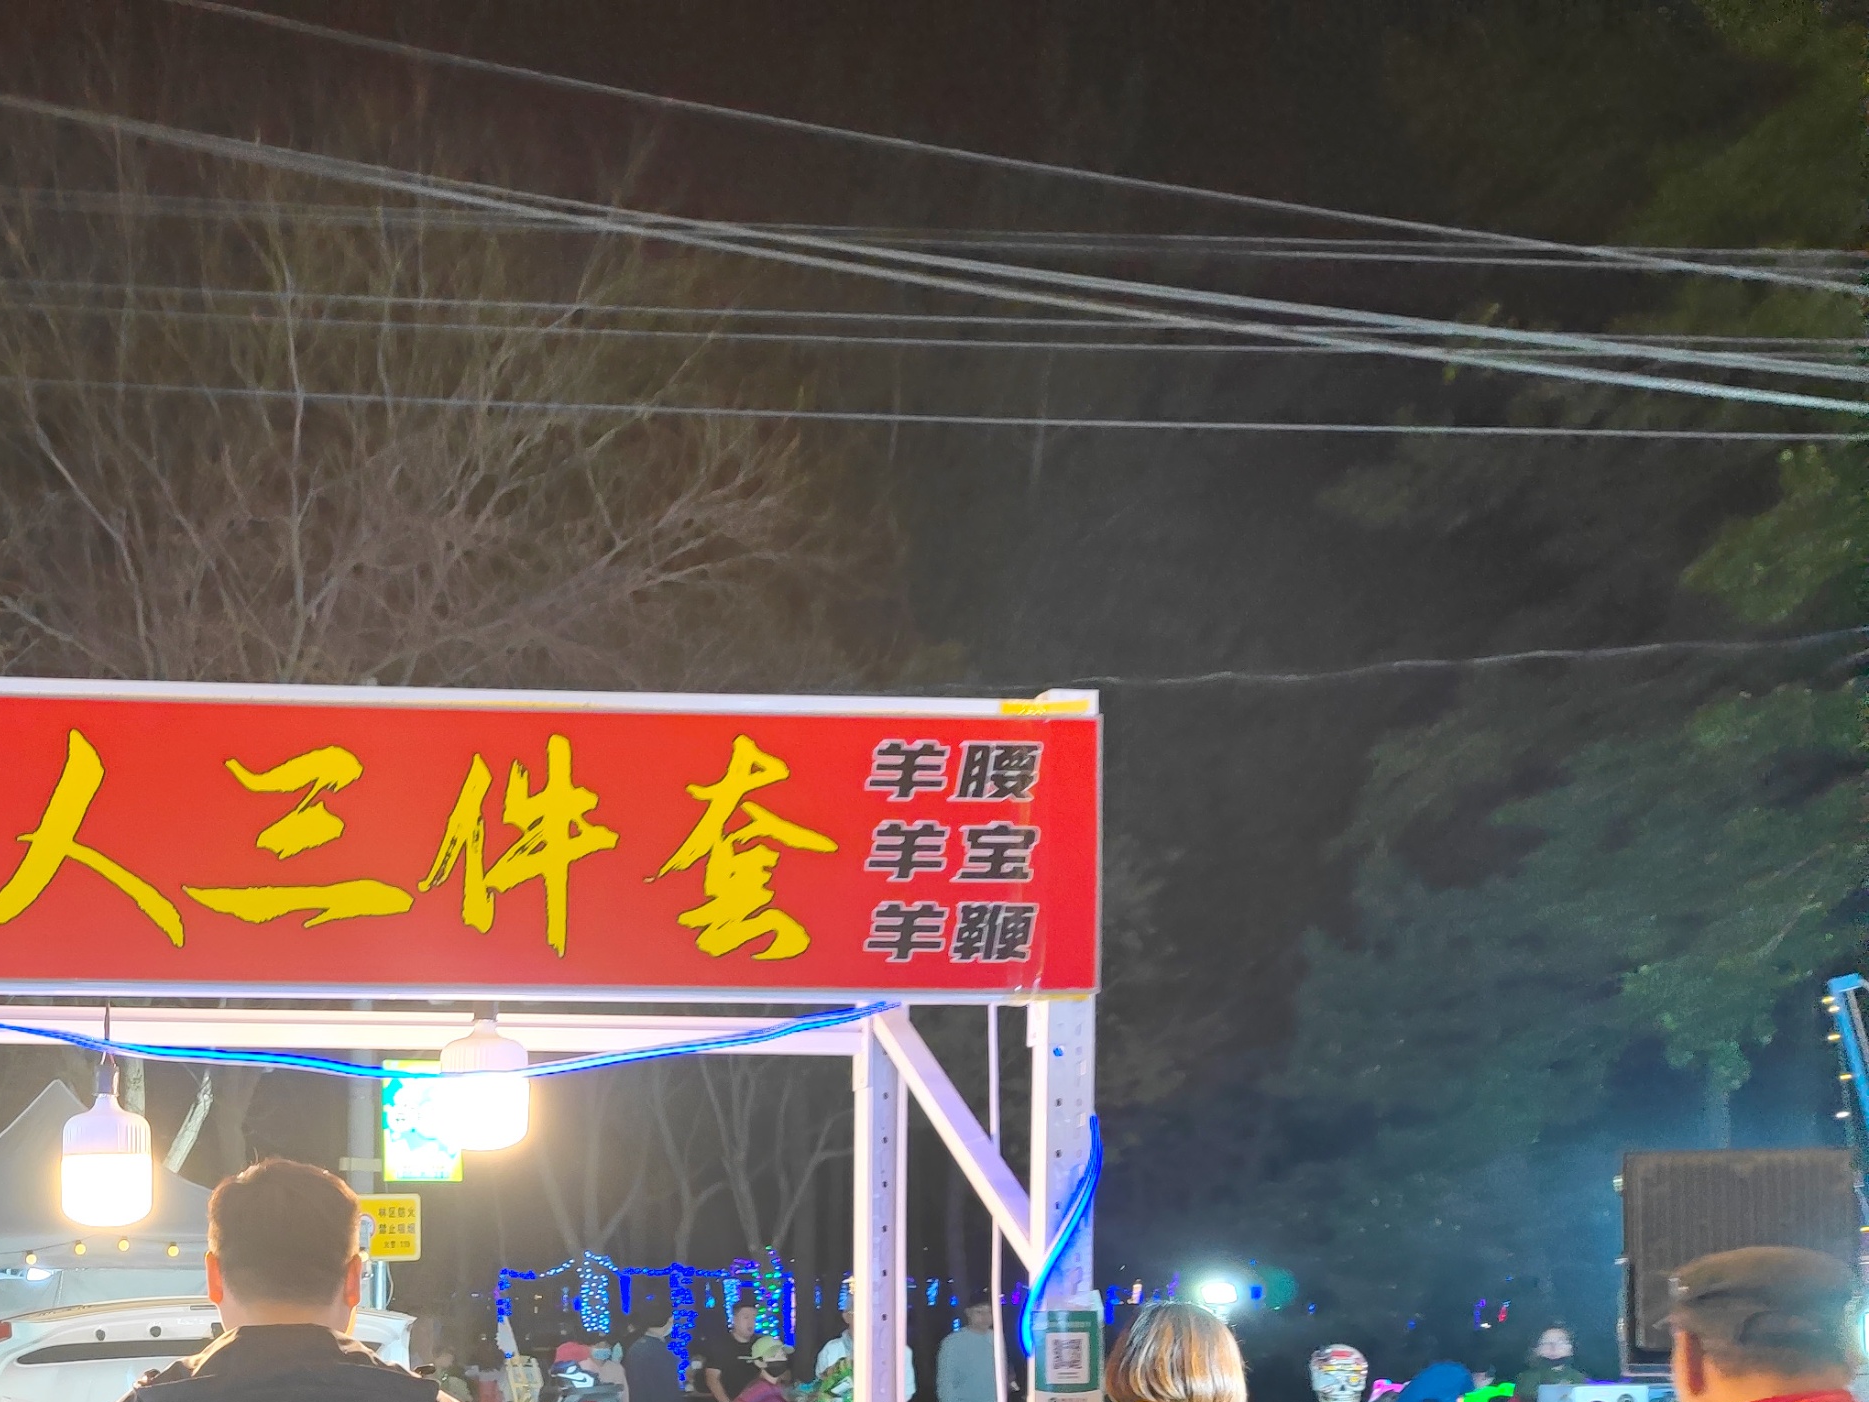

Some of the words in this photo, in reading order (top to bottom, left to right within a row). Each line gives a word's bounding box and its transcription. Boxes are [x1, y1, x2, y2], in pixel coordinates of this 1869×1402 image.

[864, 739, 1044, 802] 羊腰
[863, 820, 1041, 882] 羊宝
[862, 901, 1039, 963] 羊鞭
